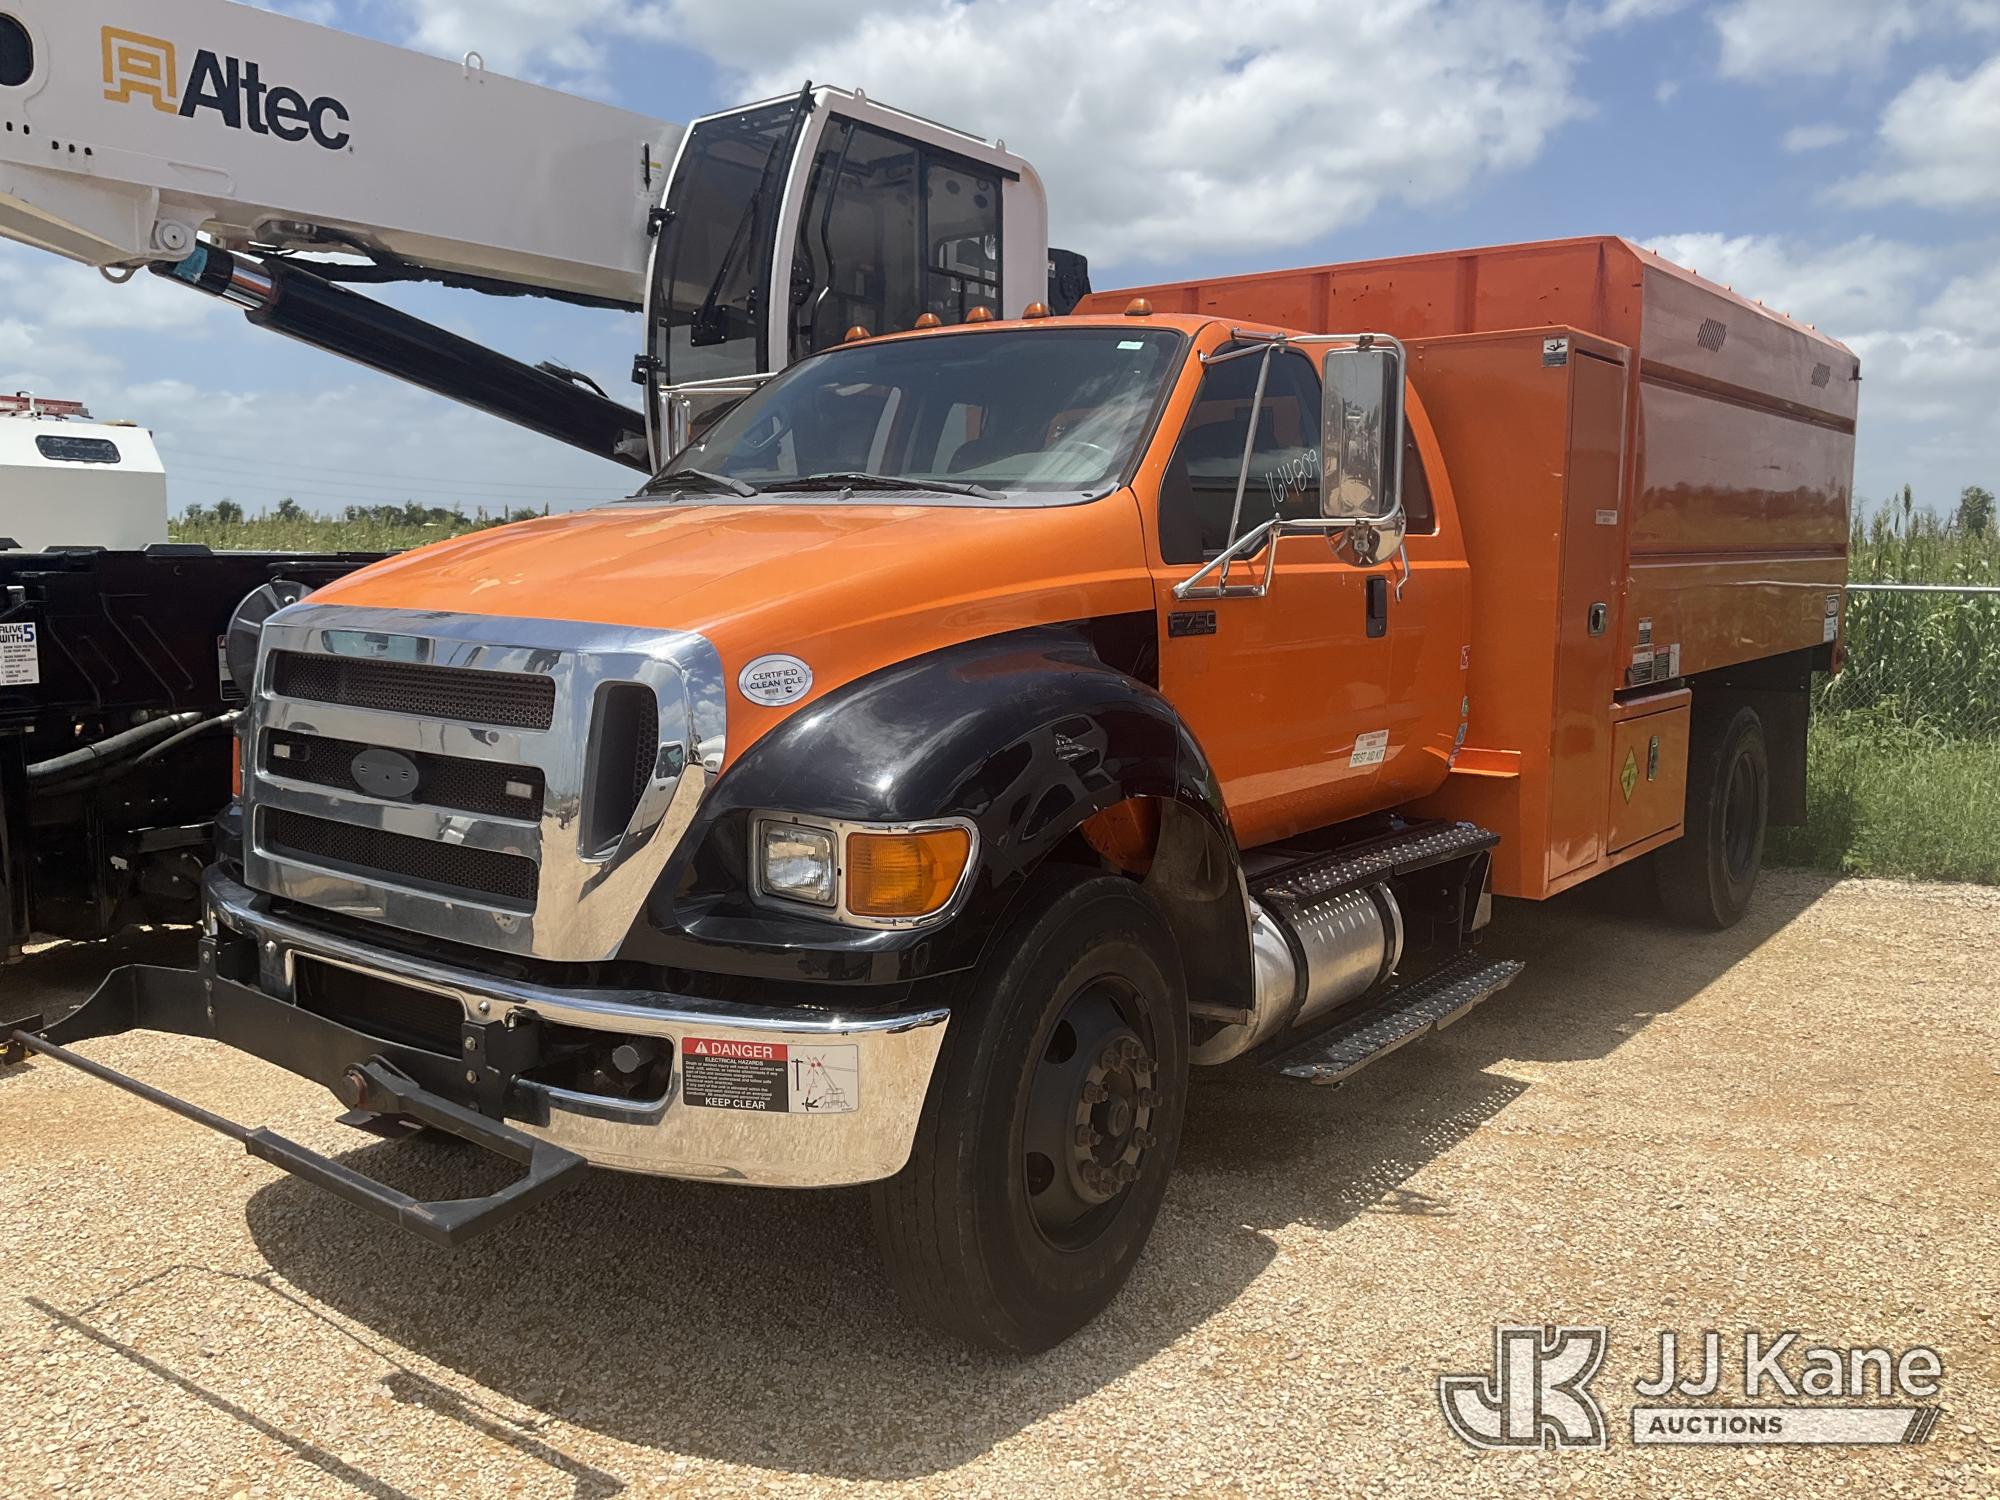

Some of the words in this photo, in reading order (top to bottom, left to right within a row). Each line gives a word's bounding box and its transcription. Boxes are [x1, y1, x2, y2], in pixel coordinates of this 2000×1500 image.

[177, 49, 351, 151] Altec
[1265, 449, 1320, 508] 1614809
[0, 634, 23, 643] WITH
[23, 624, 35, 643] 5
[750, 680, 780, 689] CLEAN
[784, 676, 803, 685] IDLE
[752, 669, 798, 680] CERTIFIED
[711, 1042, 773, 1059] DANGER
[705, 1097, 730, 1107] KEEP
[733, 1100, 765, 1109] CLEAR
